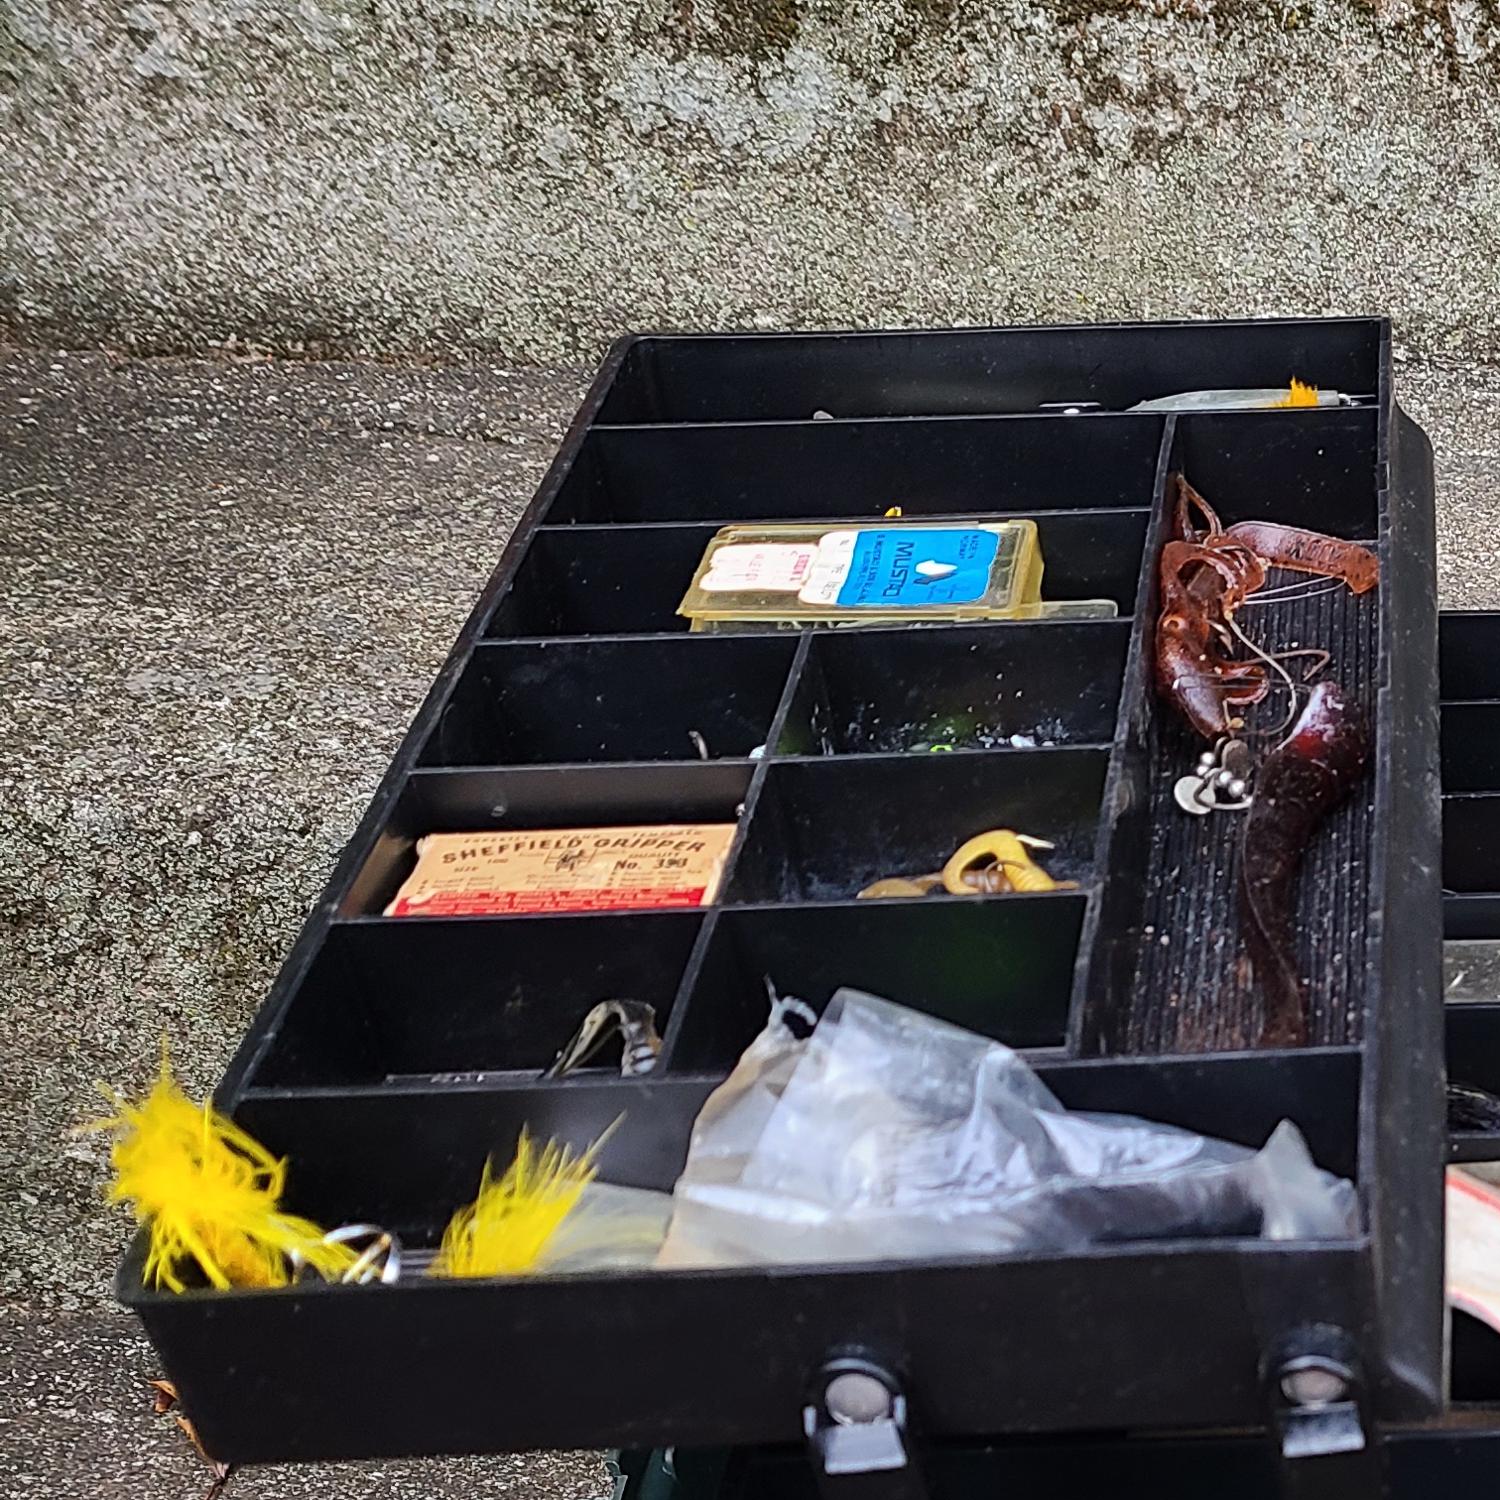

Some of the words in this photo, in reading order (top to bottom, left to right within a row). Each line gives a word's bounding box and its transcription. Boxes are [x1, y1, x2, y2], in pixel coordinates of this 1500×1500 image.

[882, 541, 914, 597] MUSTAD
[442, 839, 582, 864] SHEFFIELD
[594, 838, 706, 852] GRIPPER
